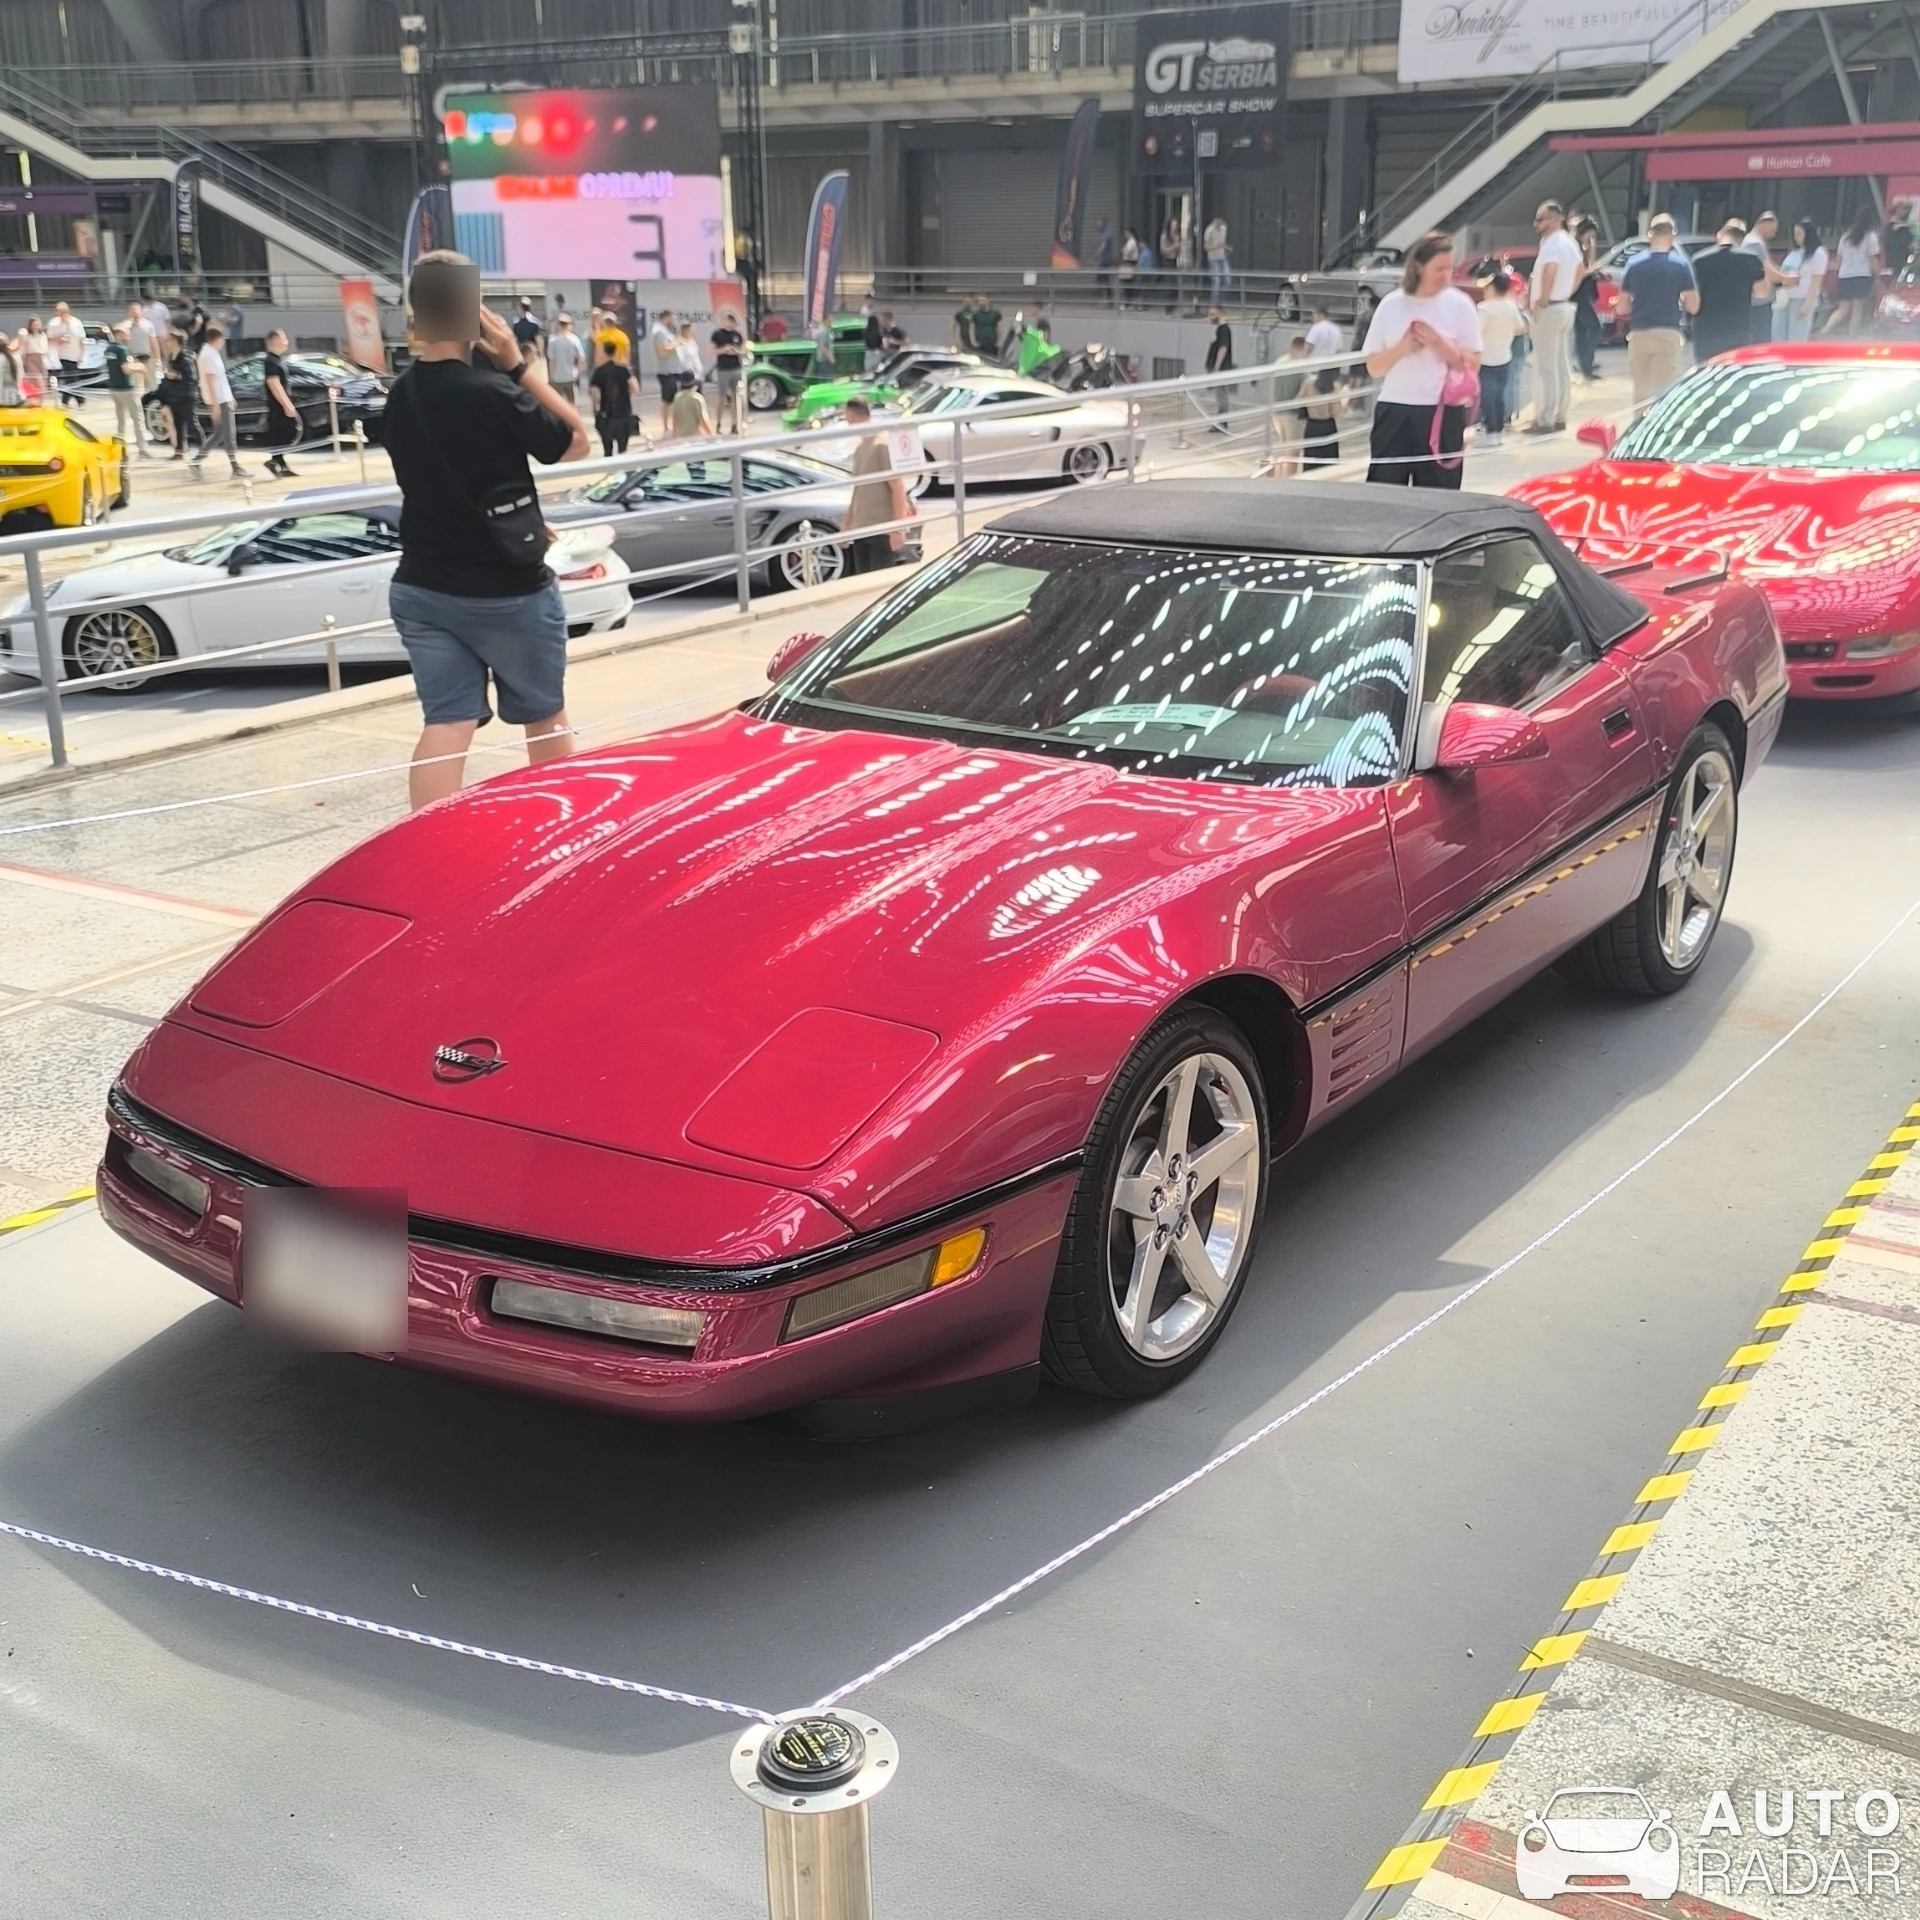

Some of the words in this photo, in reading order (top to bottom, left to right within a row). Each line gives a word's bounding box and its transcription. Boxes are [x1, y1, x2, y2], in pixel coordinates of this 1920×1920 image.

[1145, 40, 1206, 94] GT
[1196, 60, 1276, 91] SERBIA
[1144, 100, 1226, 117] SUPERCAR
[1227, 97, 1277, 114] SHOW
[178, 179, 192, 232] BLACK
